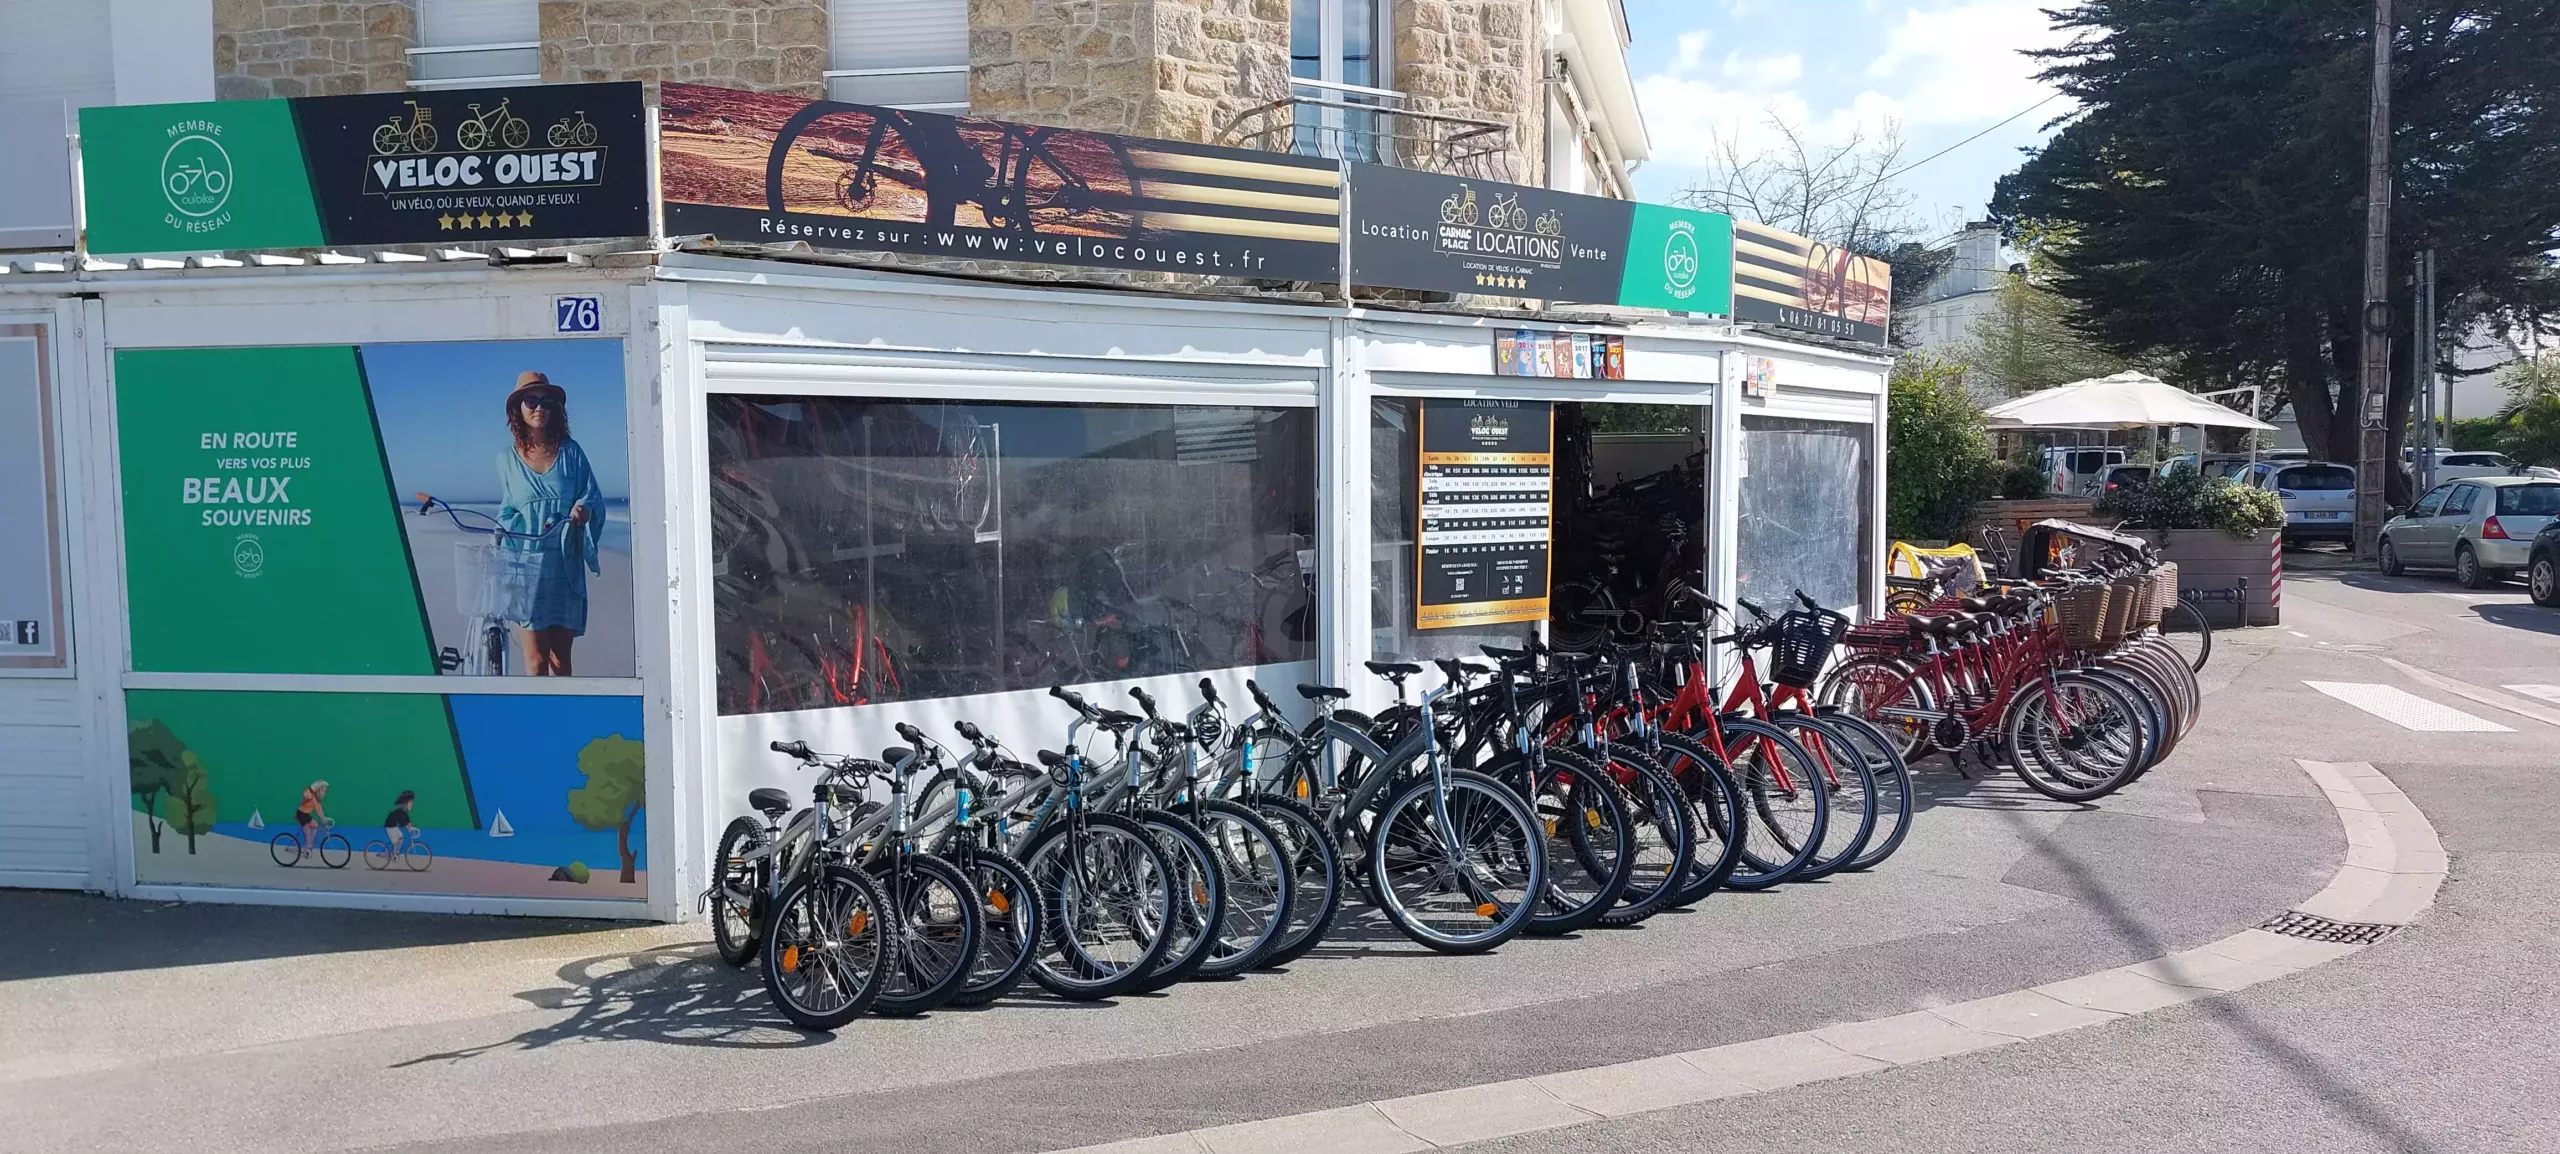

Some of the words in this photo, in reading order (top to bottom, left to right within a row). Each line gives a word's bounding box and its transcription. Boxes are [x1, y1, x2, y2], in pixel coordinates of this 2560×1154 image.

[167, 120, 222, 137] MEMBRE
[391, 199, 406, 211] UN
[407, 197, 435, 210] VÉLO,
[436, 196, 452, 209] OÙ
[454, 198, 464, 208] JE
[466, 196, 494, 208] VEUX,
[496, 195, 534, 207] QUAND
[536, 194, 547, 206] JE
[547, 193, 575, 204] VEUX
[165, 213, 182, 229] DU
[187, 211, 231, 233] RÉSEAU
[1361, 219, 1429, 241] Location
[1669, 219, 1696, 235] MEMBRE
[760, 218, 864, 240] Réservez
[878, 232, 910, 244] sur
[1440, 226, 1472, 240] CARNAC
[1442, 238, 1469, 250] PLAGE
[1476, 231, 1560, 259] LOCATIONS
[1571, 243, 1607, 260] Vente
[1664, 282, 1674, 295] DU
[1674, 285, 1696, 299] RÉSEAU
[560, 300, 596, 329] 76
[1789, 310, 1800, 325] 06
[1803, 313, 1813, 328] 27
[1831, 320, 1841, 333] 05
[1845, 322, 1855, 336] 50
[201, 433, 227, 449] EN
[233, 432, 297, 449] ROUTE
[217, 458, 247, 469] VERS
[252, 457, 277, 469] VOS
[280, 457, 311, 469] PLUS
[183, 477, 291, 504] BEAUX
[202, 509, 313, 526] SOUVENIRS
